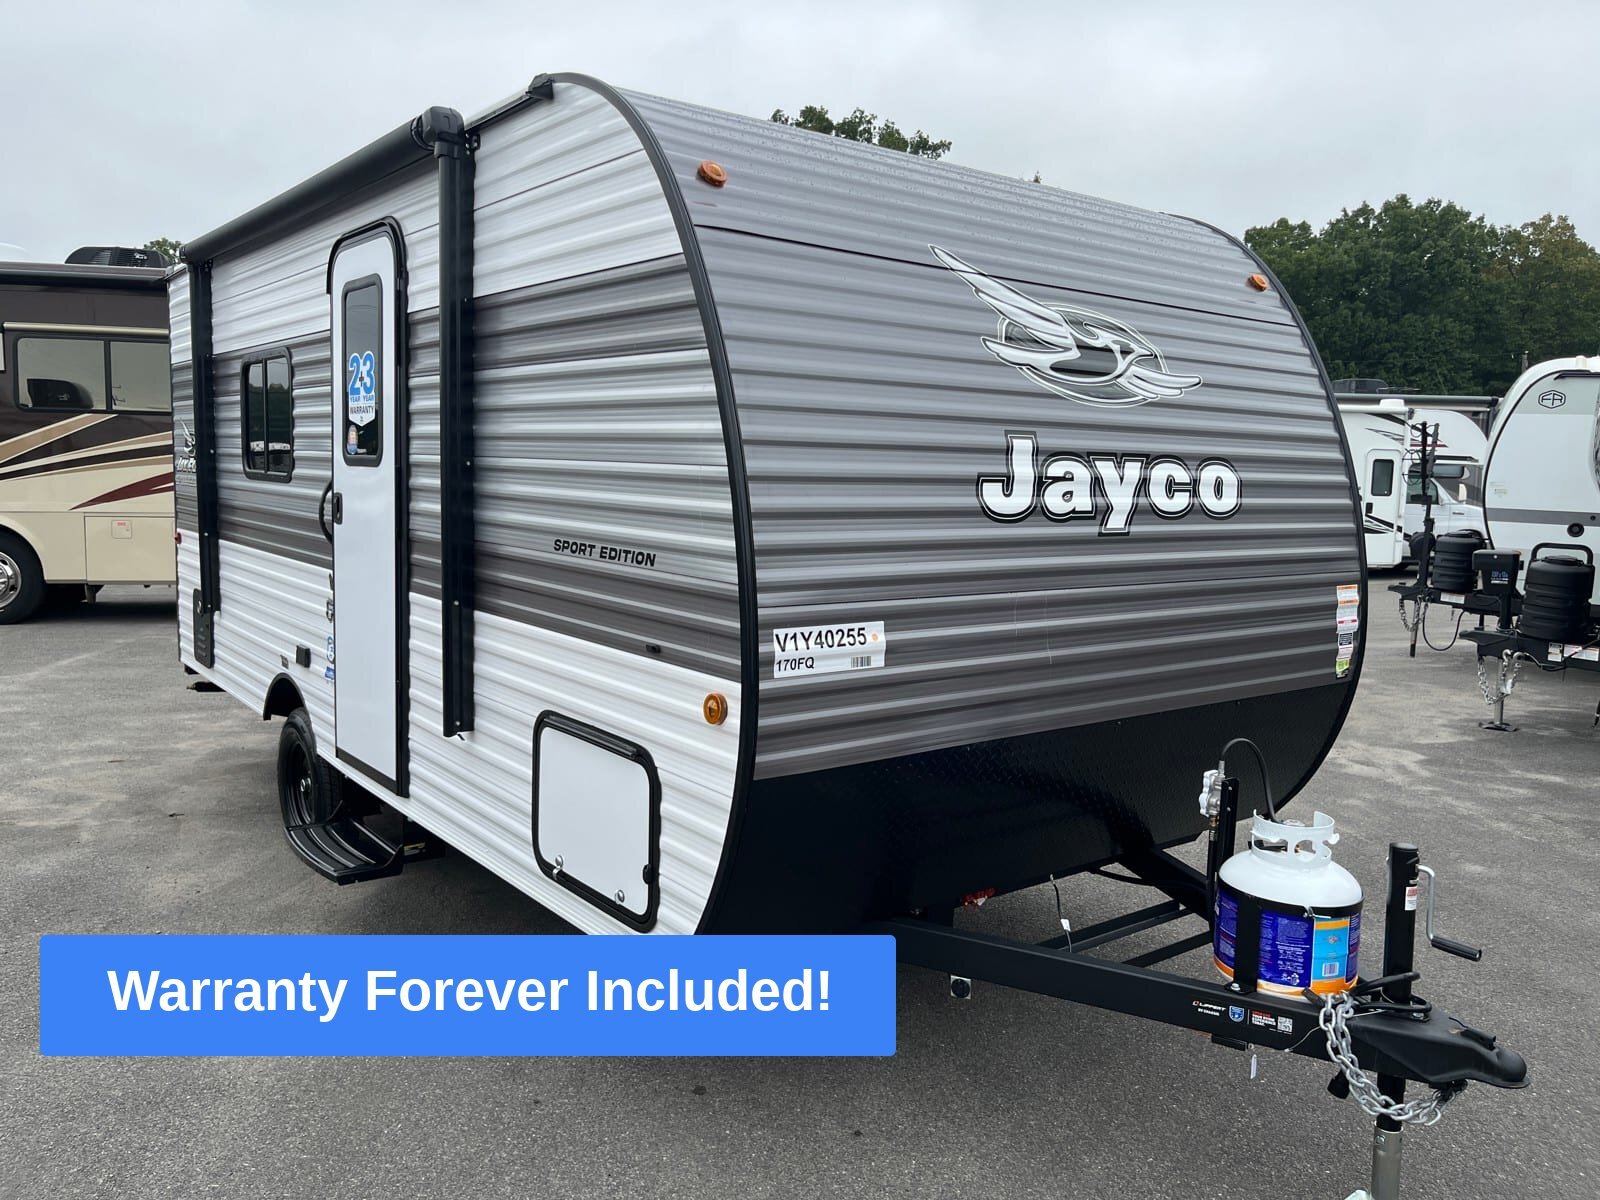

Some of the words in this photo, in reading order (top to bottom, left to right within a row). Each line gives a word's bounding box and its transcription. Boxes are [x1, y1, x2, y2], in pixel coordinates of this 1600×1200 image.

[350, 395, 360, 403] YEAR
[363, 394, 374, 402] YEAR
[350, 405, 374, 415] WARRANTY
[978, 432, 1242, 536] Jayco
[553, 538, 596, 557] SPORT
[599, 545, 657, 567] EDITION
[775, 627, 867, 652] V1Y40255
[776, 656, 815, 672] 170FQ
